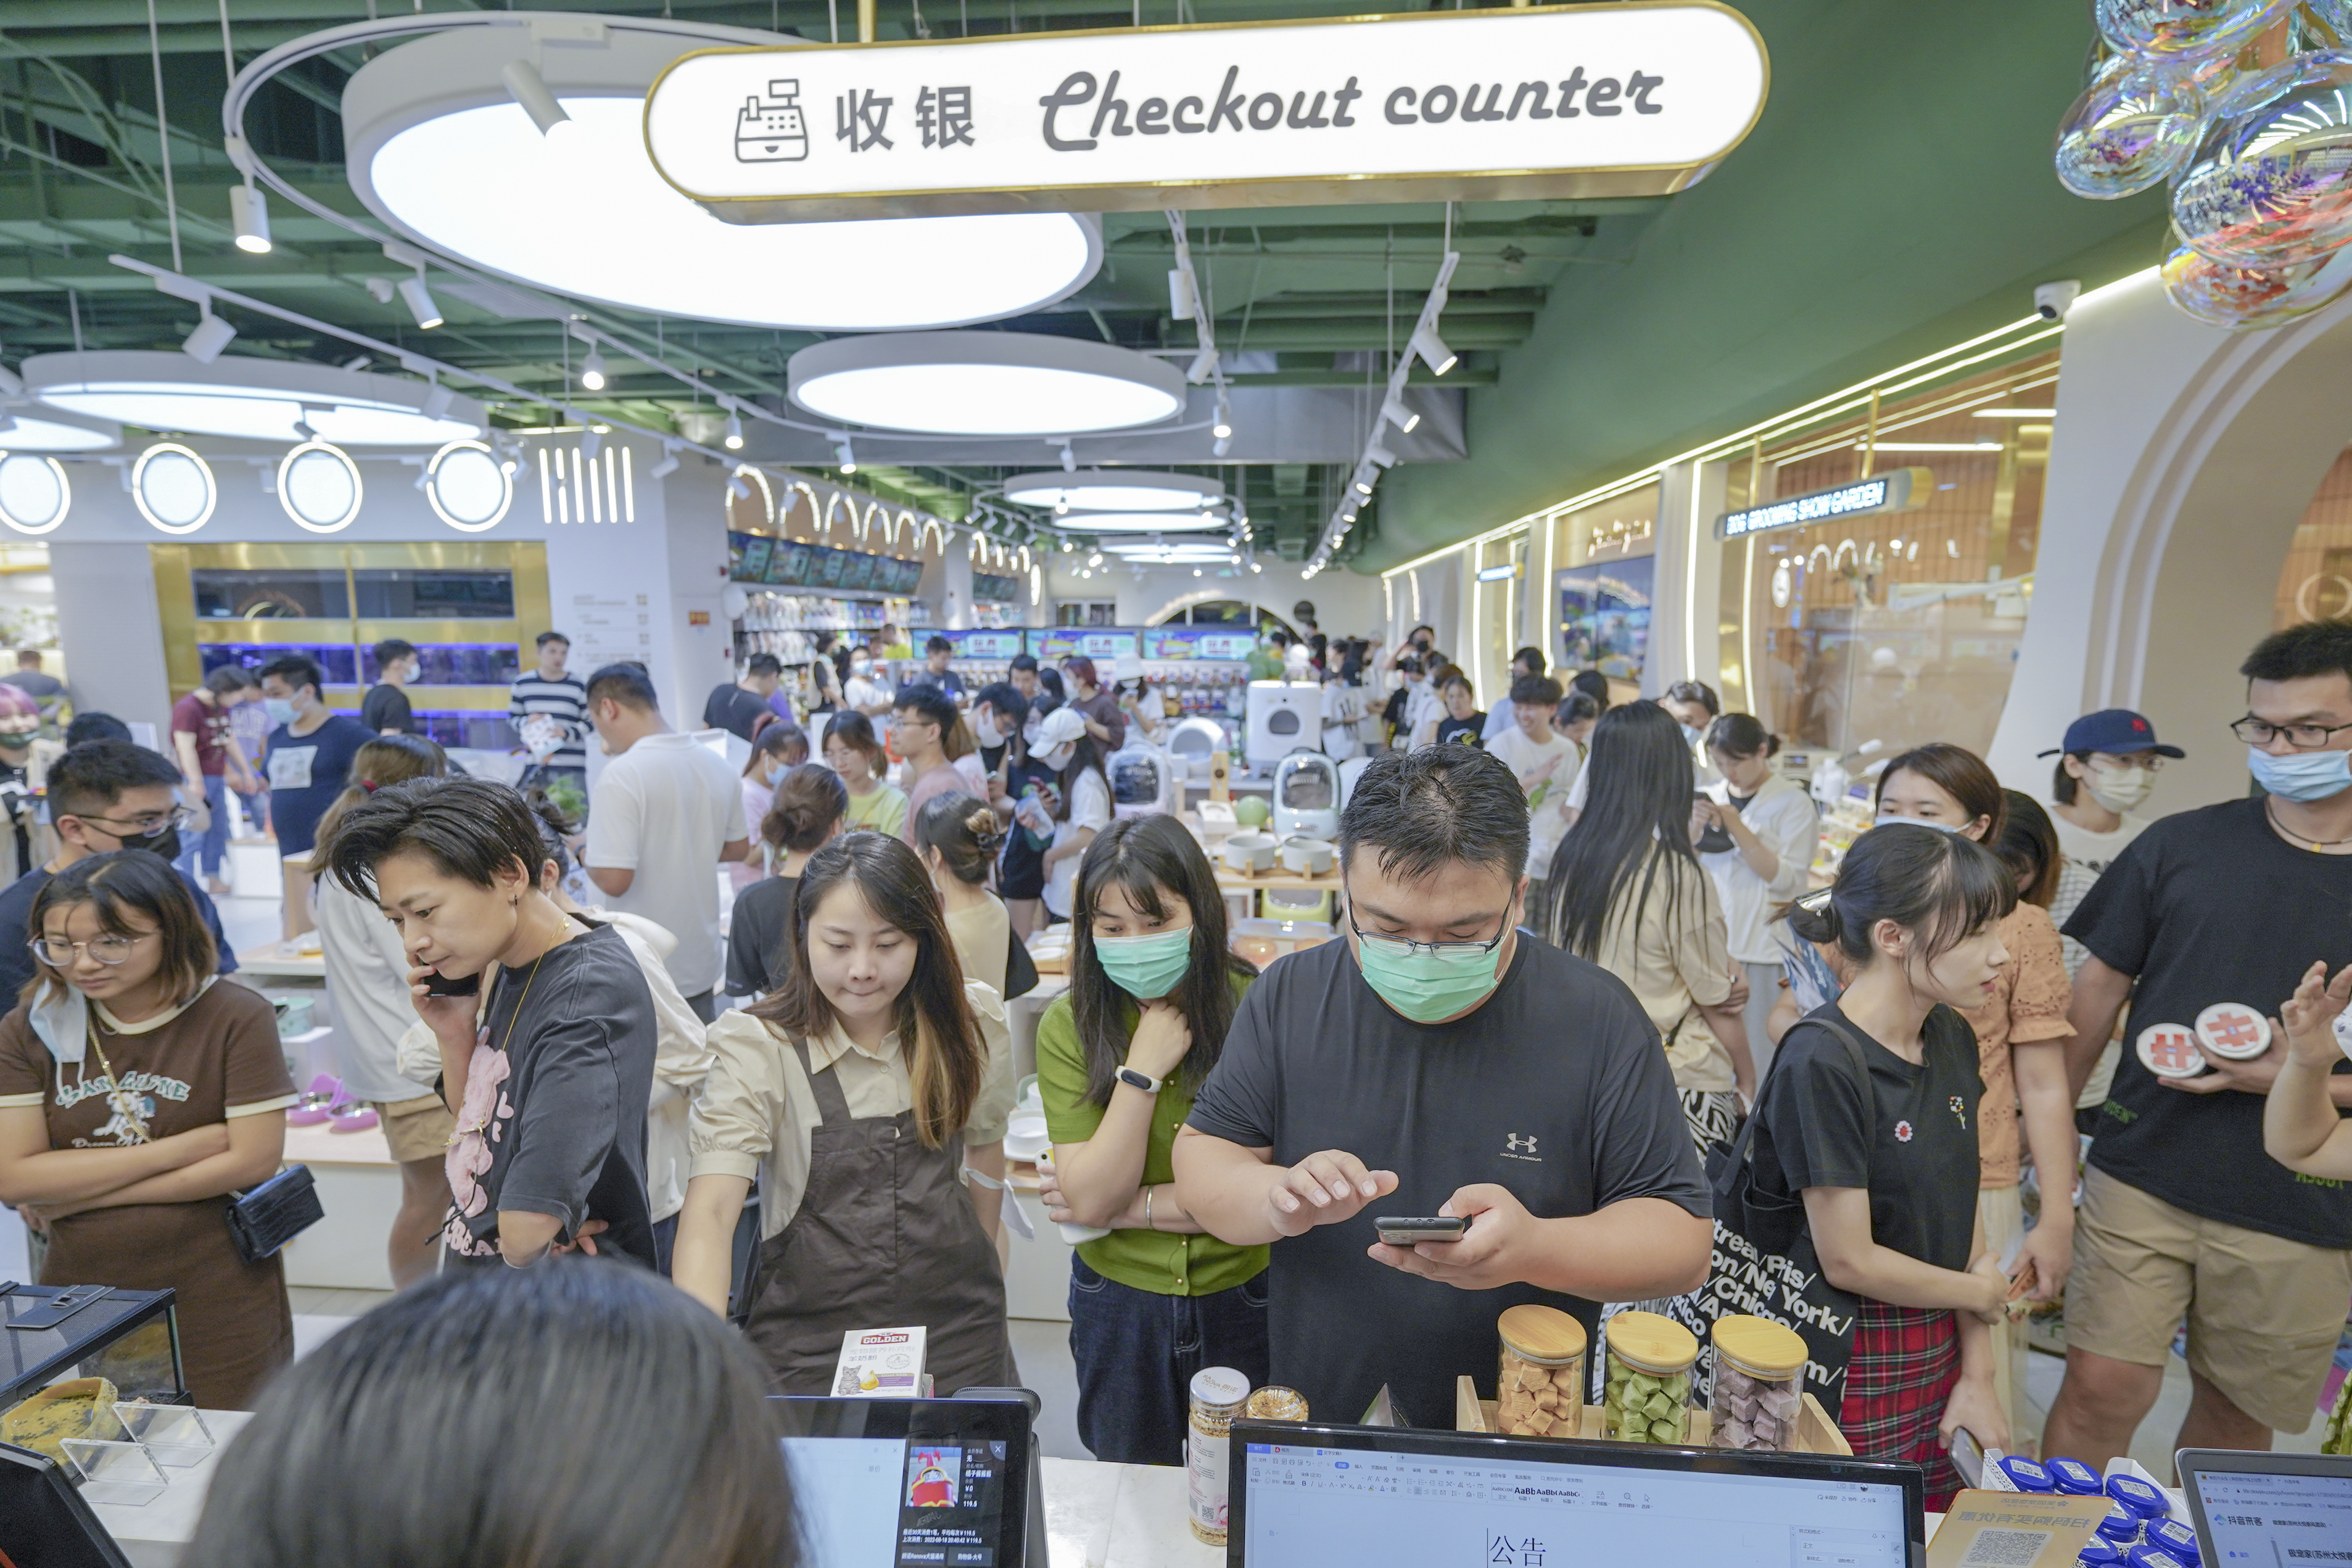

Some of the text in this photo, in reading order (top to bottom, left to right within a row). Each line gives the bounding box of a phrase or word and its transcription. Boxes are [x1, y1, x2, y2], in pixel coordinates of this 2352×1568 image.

[836, 86, 975, 152] 收银
[1039, 65, 1663, 151] Checkout counter
[1782, 1284, 1853, 1336] York/
[849, 1346, 915, 1355] 宠物营养补充剂
[864, 1335, 907, 1343] GOLDEN
[2227, 1516, 2263, 1526] 抖音来客
[1489, 1535, 1547, 1567] 公告
